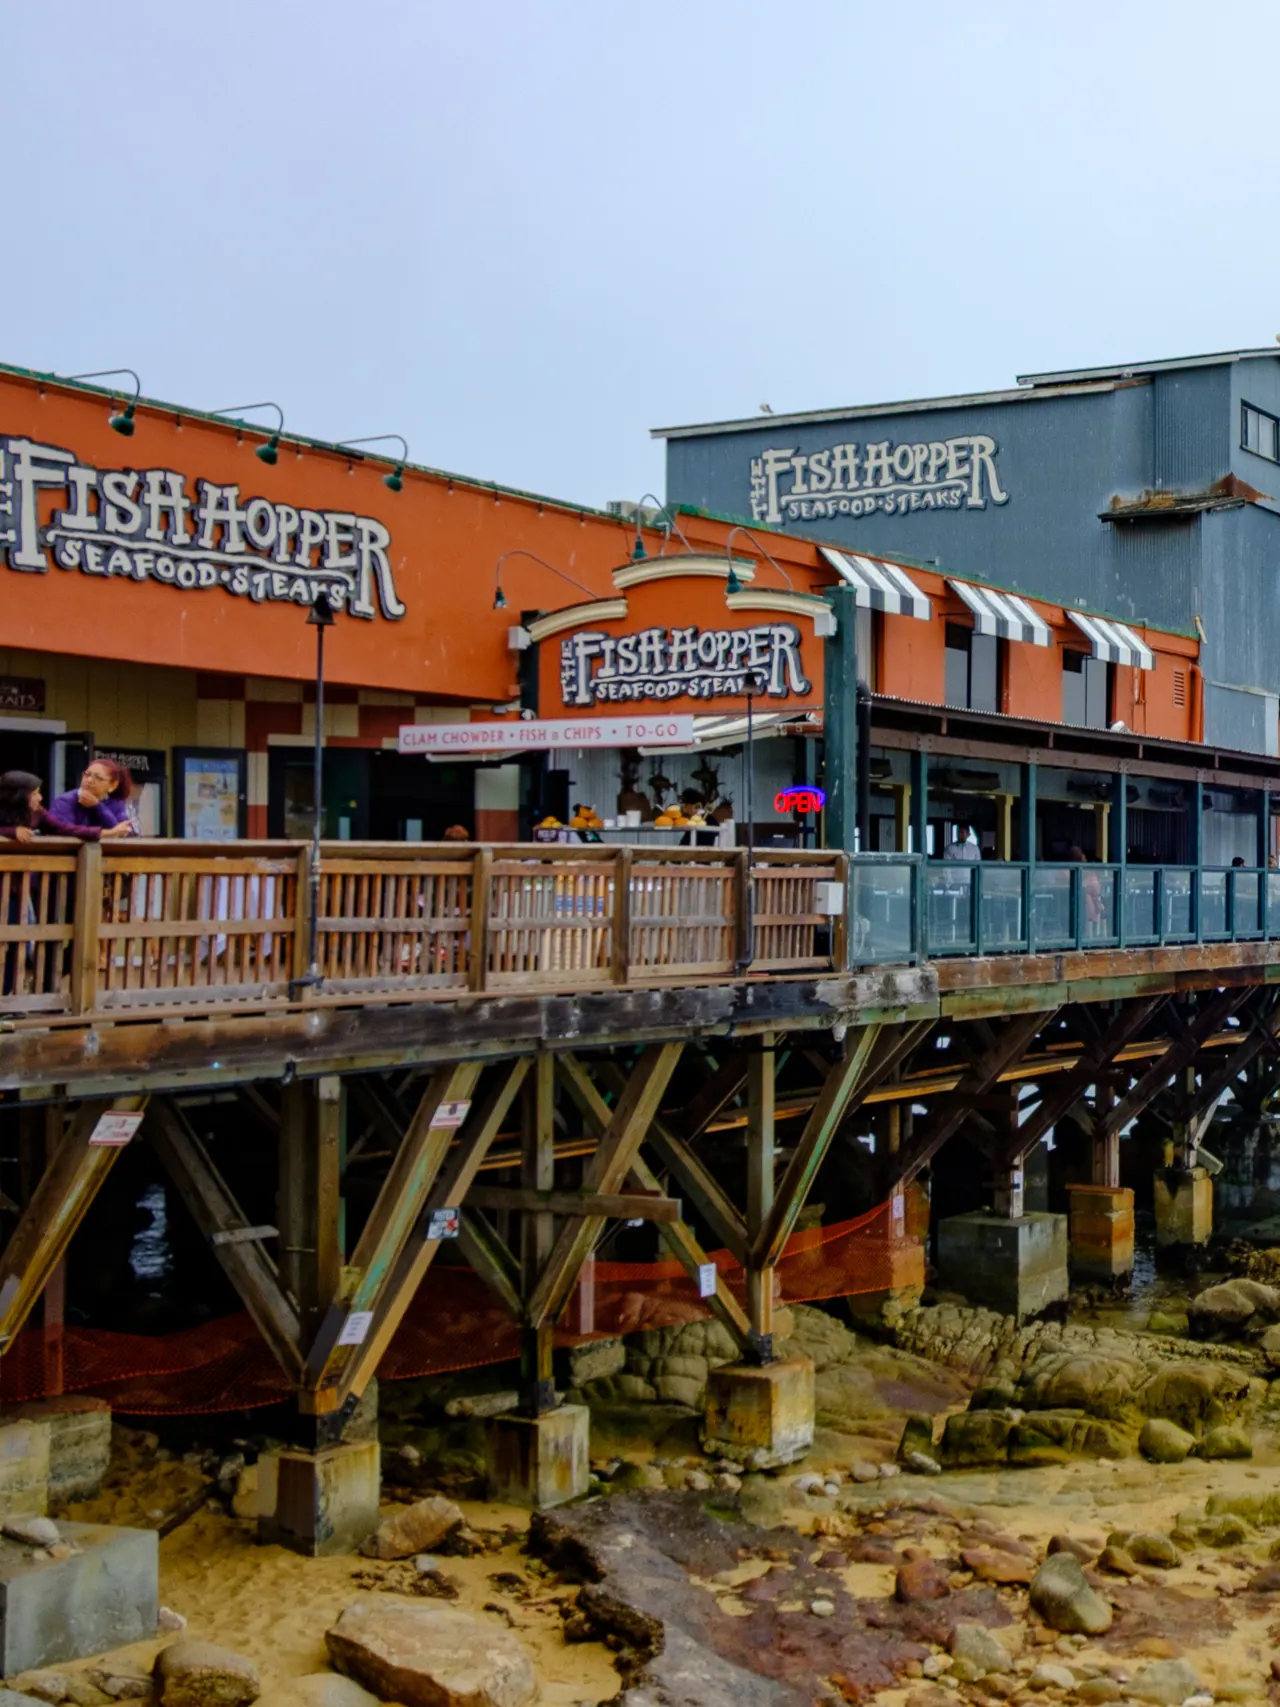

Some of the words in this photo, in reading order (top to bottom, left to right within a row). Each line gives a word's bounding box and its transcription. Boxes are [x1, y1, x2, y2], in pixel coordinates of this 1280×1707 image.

[750, 457, 767, 521] THE
[762, 444, 859, 523] FISH
[864, 435, 1008, 505] HOPPER
[788, 498, 879, 519] SEAFOOD
[885, 489, 962, 512] STEAKS
[8, 439, 190, 568] FISH
[199, 482, 406, 618] HOPPER
[60, 539, 216, 588] SEAFOOD
[560, 640, 578, 702] THE
[573, 629, 665, 704] FISH
[668, 626, 804, 694] HOPPER
[596, 680, 680, 700] SEAFOOD
[402, 733, 438, 746] CLAM
[441, 729, 505, 744] CHOWDER
[519, 728, 547, 742] FISH
[563, 726, 602, 740] CHIPS
[625, 723, 678, 739] TO-GO
[773, 791, 821, 813] OPEN
